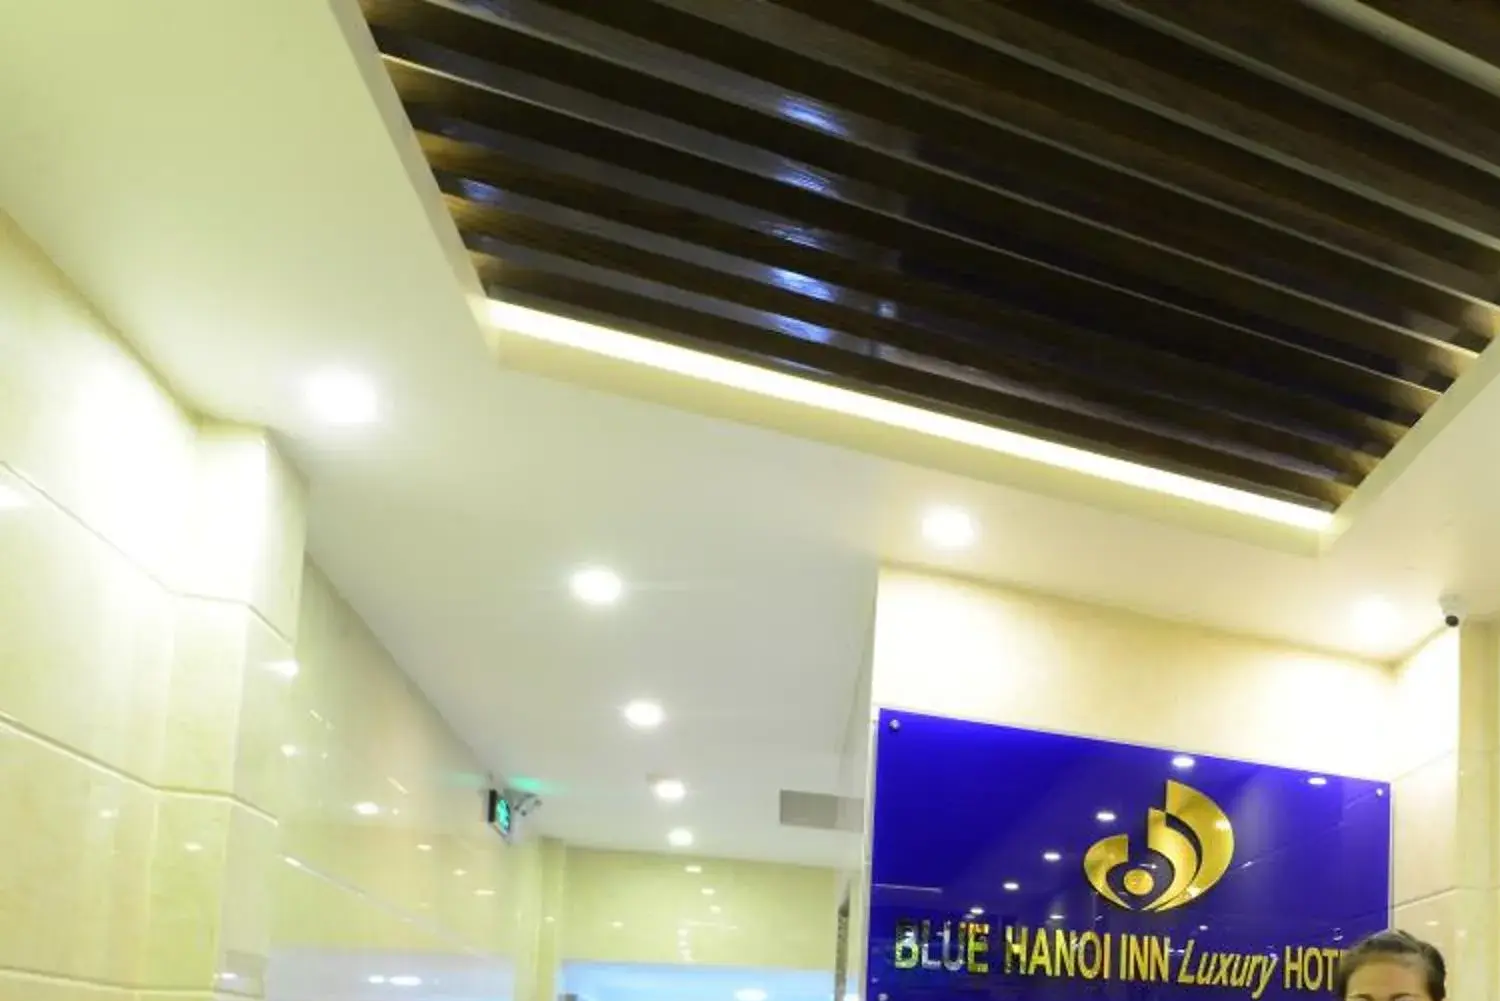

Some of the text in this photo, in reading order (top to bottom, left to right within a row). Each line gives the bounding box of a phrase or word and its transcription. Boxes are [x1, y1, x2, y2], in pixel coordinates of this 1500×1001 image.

[895, 919, 1344, 1000] BLUE HANOI INN Luxury HOT
